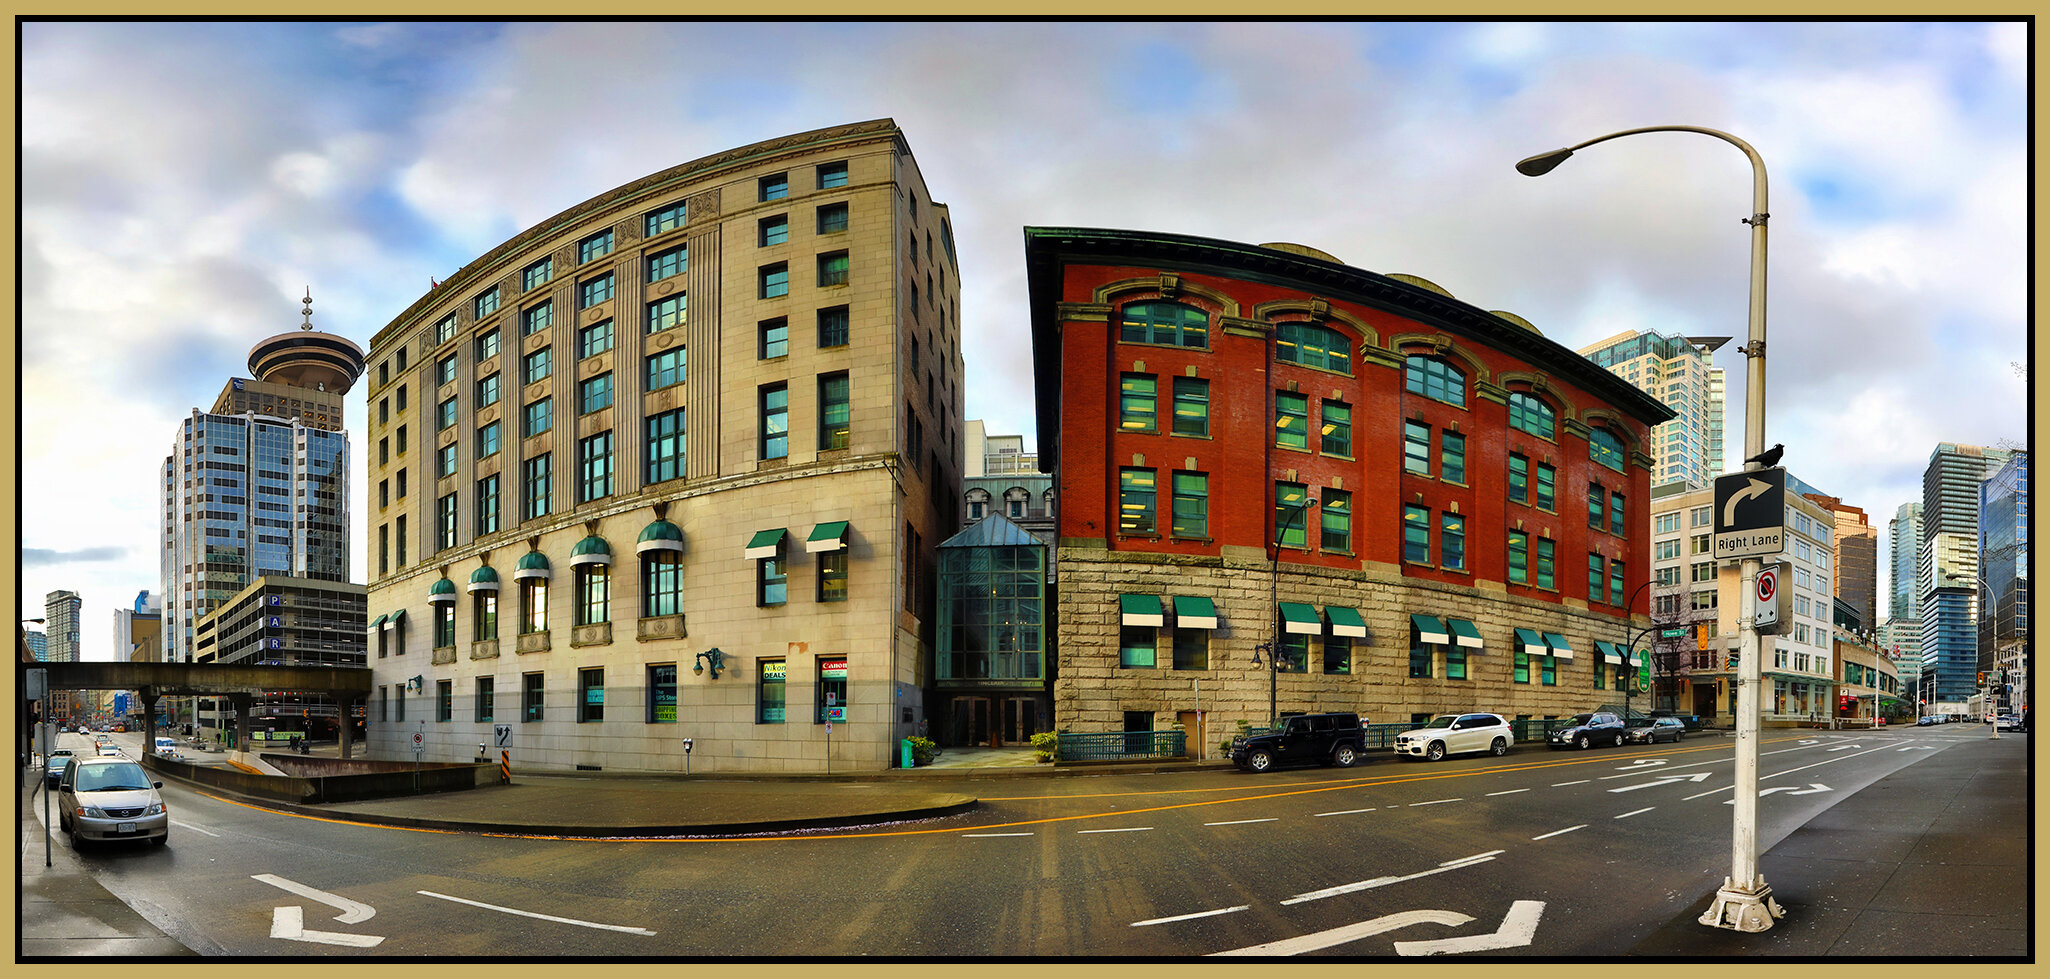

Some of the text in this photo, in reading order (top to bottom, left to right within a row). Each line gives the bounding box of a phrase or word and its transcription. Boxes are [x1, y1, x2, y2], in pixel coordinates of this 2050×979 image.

[1719, 534, 1779, 551] Right Lane
[764, 663, 787, 672] Nikon
